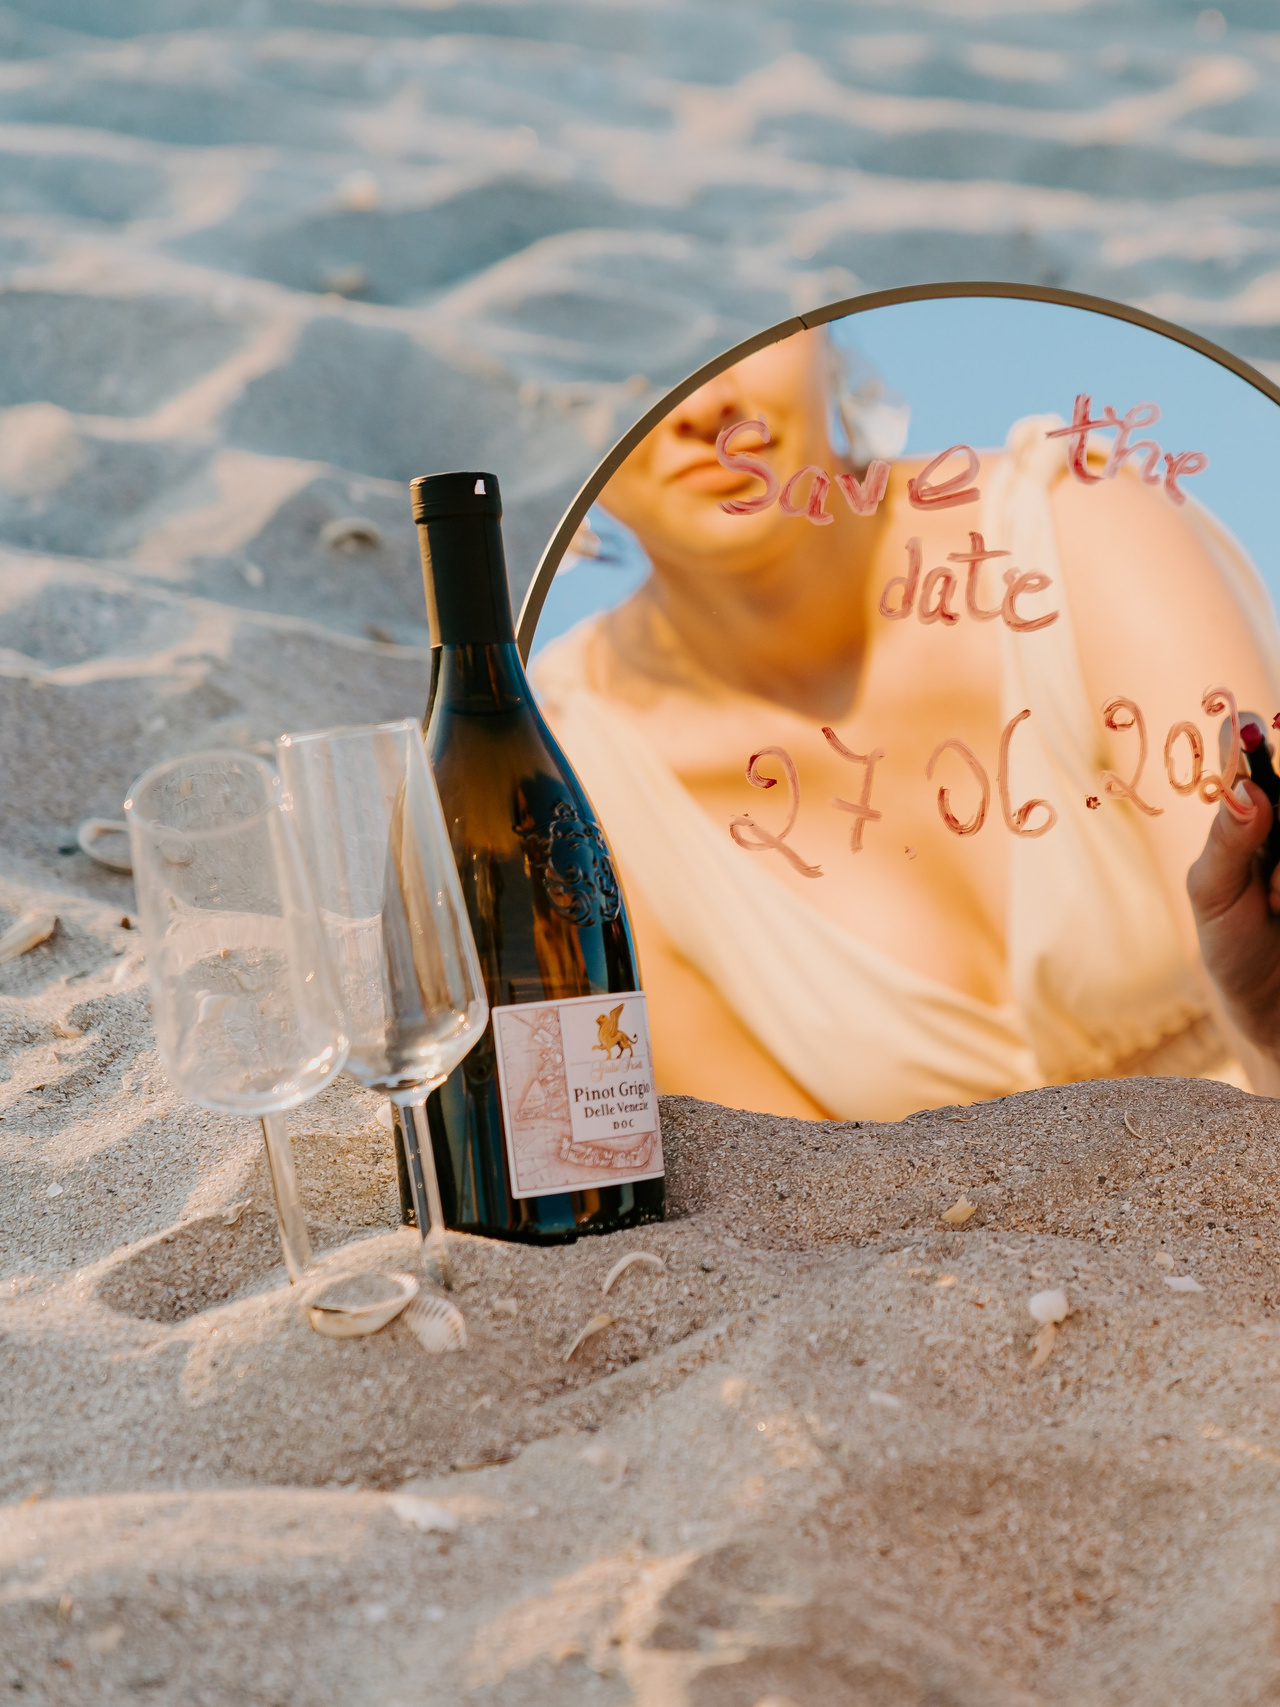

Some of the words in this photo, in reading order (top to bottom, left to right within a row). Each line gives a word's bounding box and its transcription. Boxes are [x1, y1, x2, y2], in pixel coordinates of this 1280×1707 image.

[716, 415, 981, 526] Save
[1045, 393, 1209, 505] the
[879, 531, 1060, 632] date
[574, 1087, 615, 1103] Pinot
[619, 1080, 650, 1099] Grigio
[584, 1104, 615, 1118] Delle
[617, 1100, 649, 1113] Venezie
[613, 1119, 635, 1130] DOC
